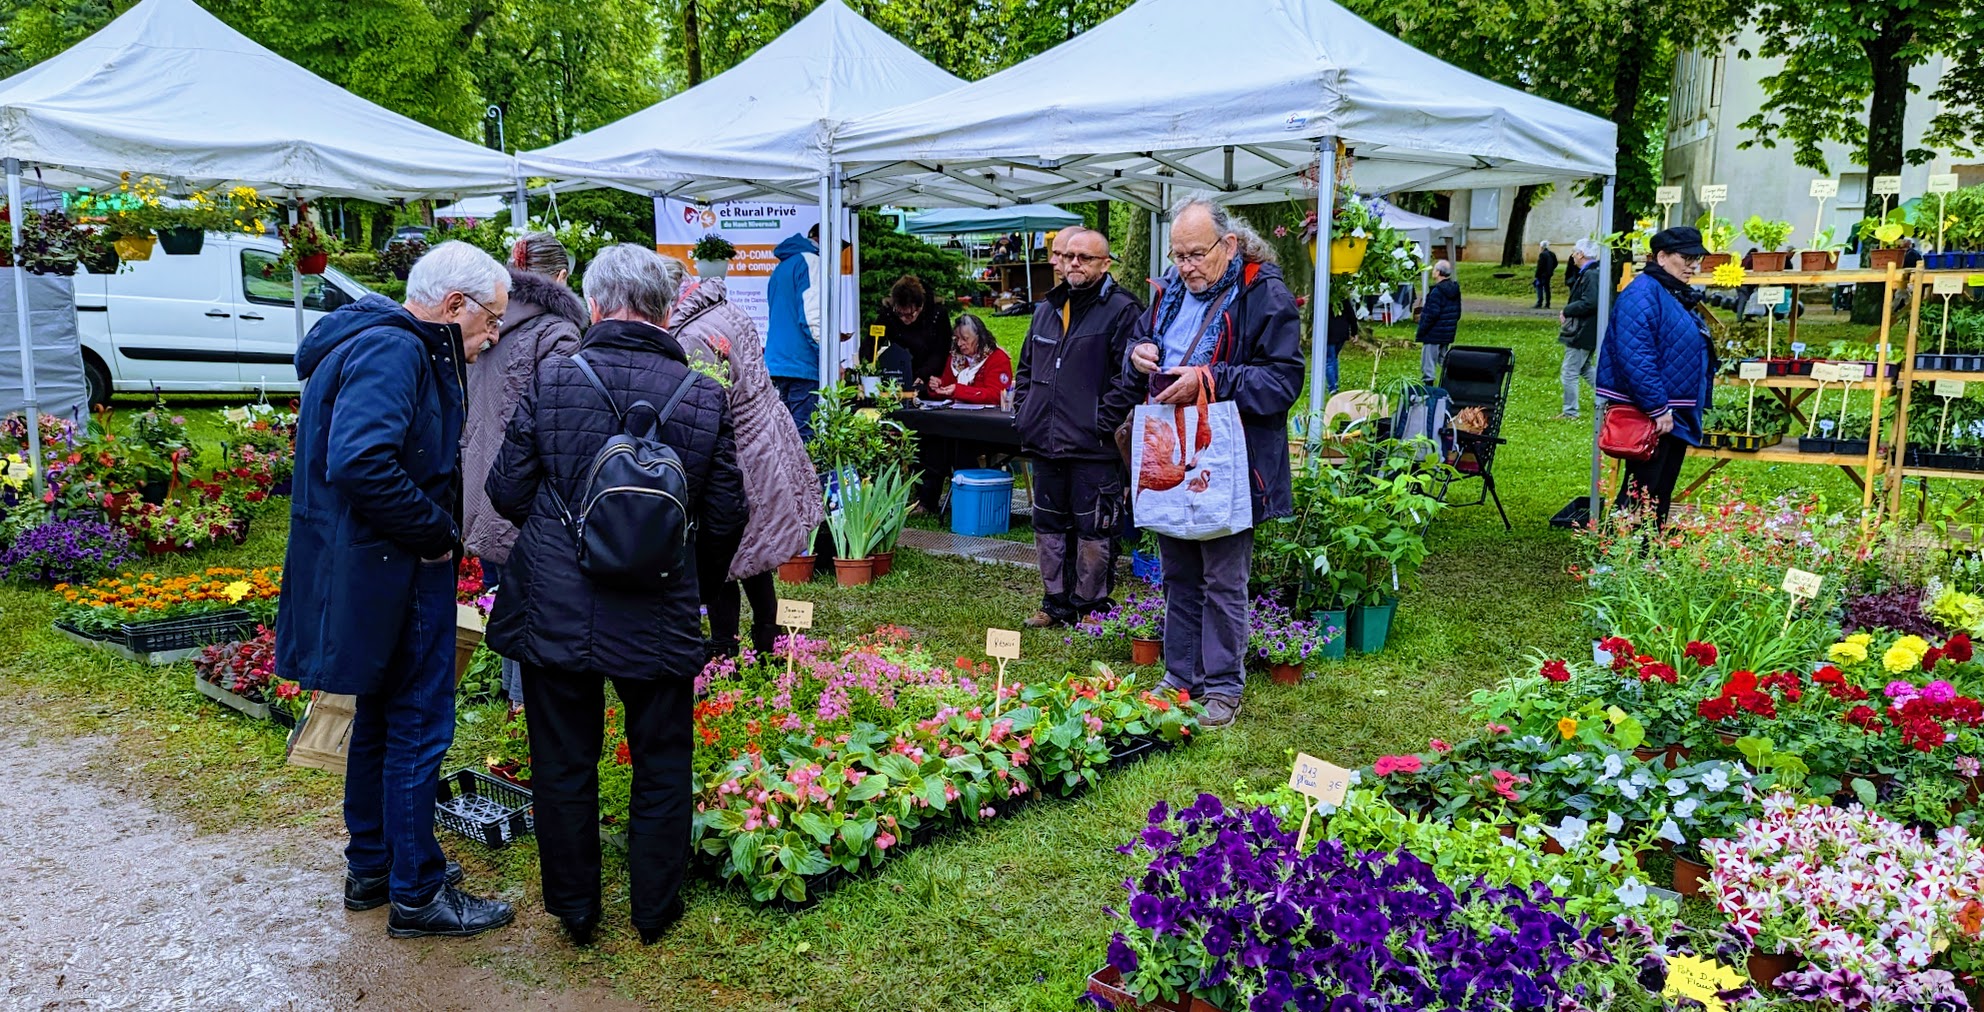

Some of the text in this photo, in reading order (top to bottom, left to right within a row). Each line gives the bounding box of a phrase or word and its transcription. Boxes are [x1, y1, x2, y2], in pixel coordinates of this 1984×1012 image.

[720, 205, 797, 217] et Rural Privé
[749, 220, 778, 228] Nivernais
[736, 263, 747, 271] de
[748, 264, 778, 273] compa
